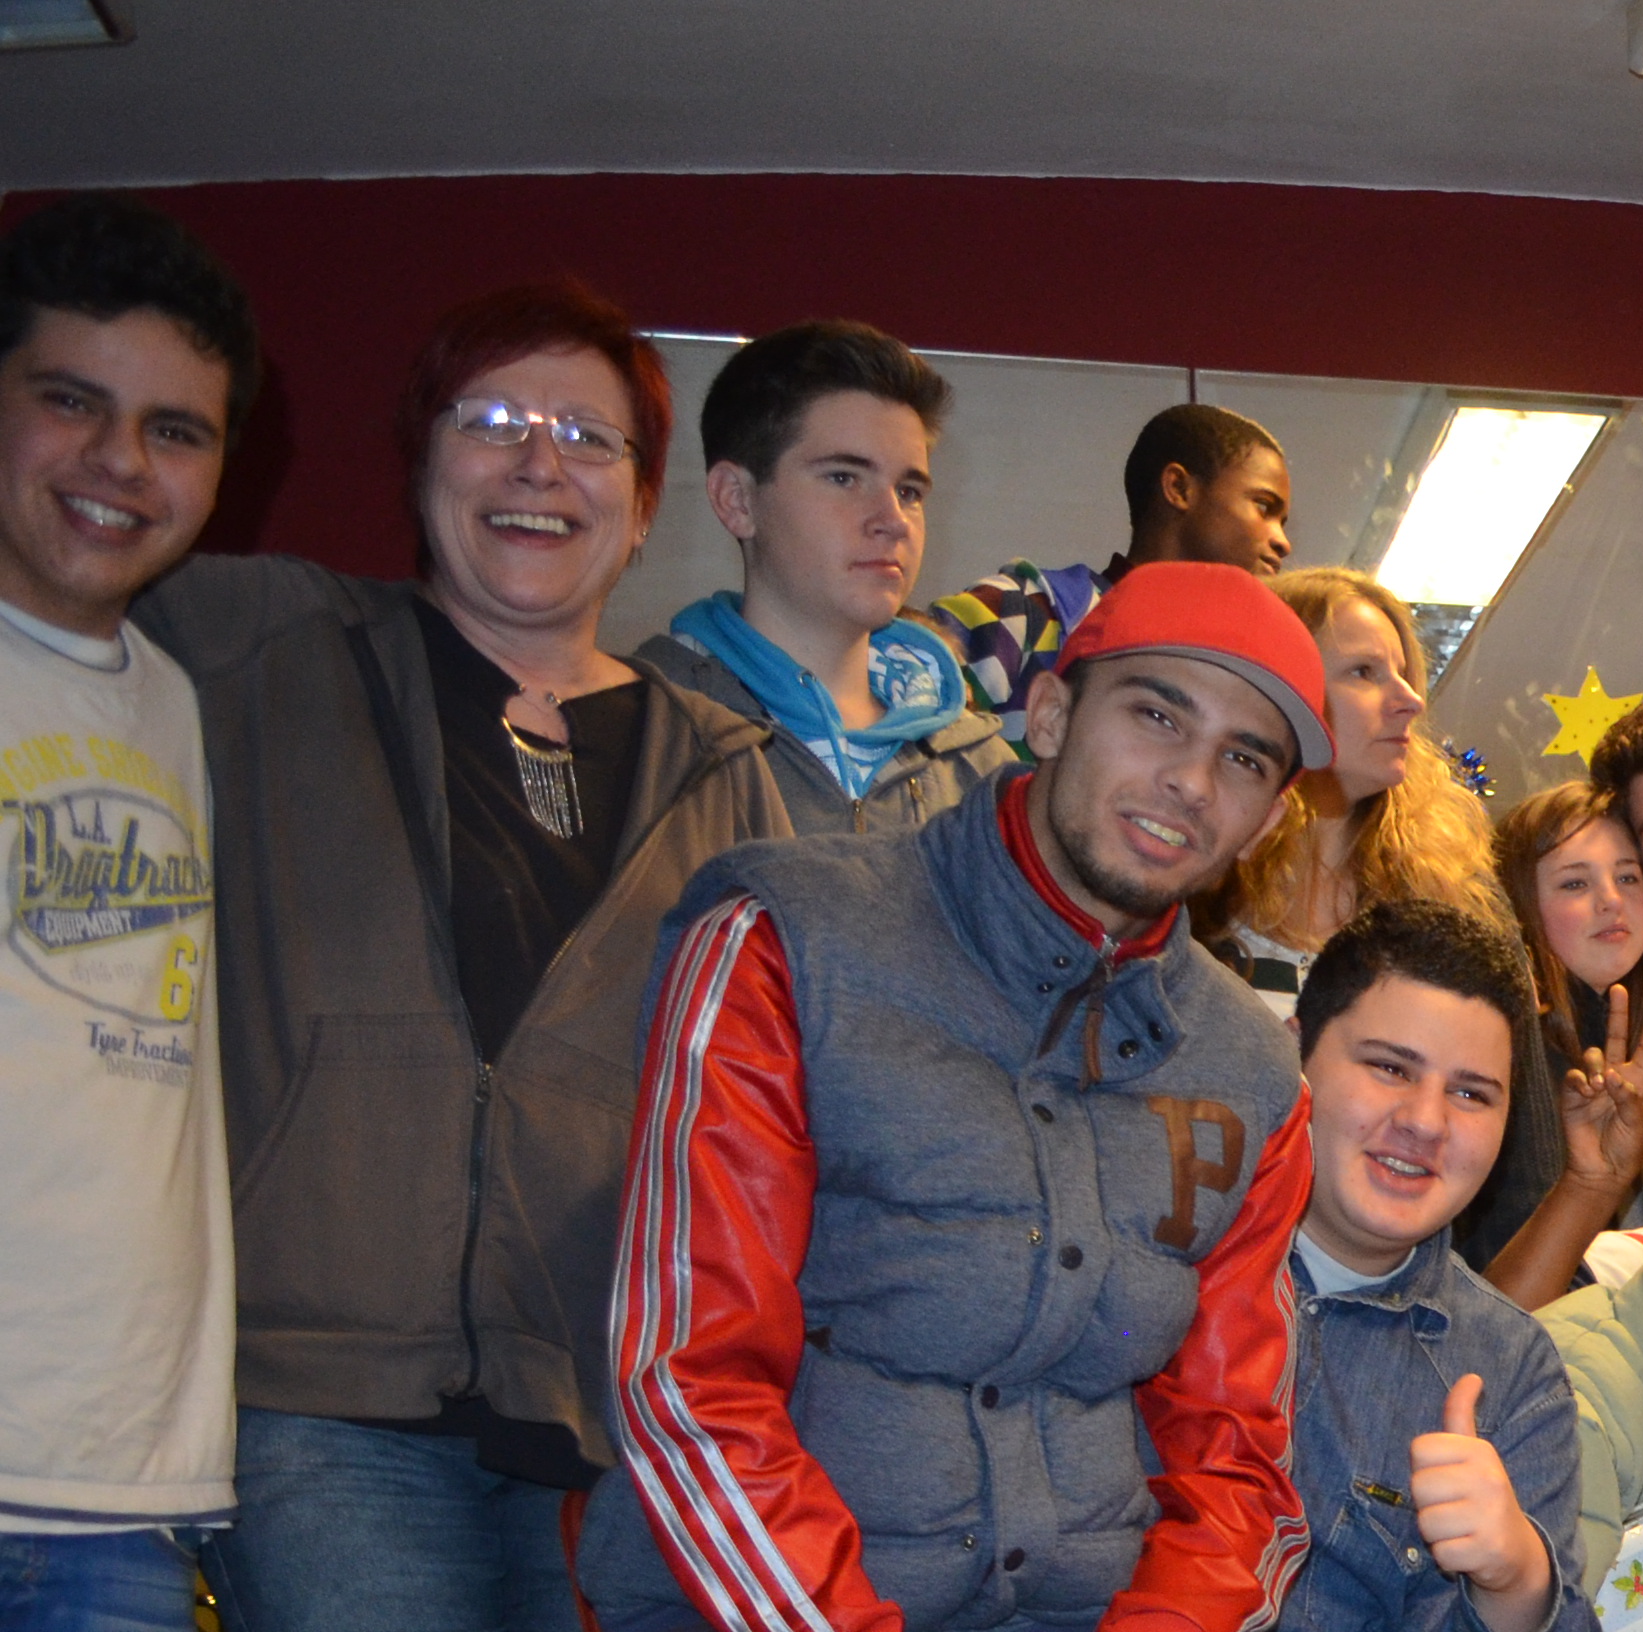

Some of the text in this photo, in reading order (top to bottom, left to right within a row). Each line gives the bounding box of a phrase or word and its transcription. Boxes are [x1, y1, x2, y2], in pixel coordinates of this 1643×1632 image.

[45, 911, 133, 947] EQUIPMENT
[159, 932, 199, 1023] 6
[85, 1020, 127, 1056] Tyre
[1146, 1095, 1246, 1251] P
